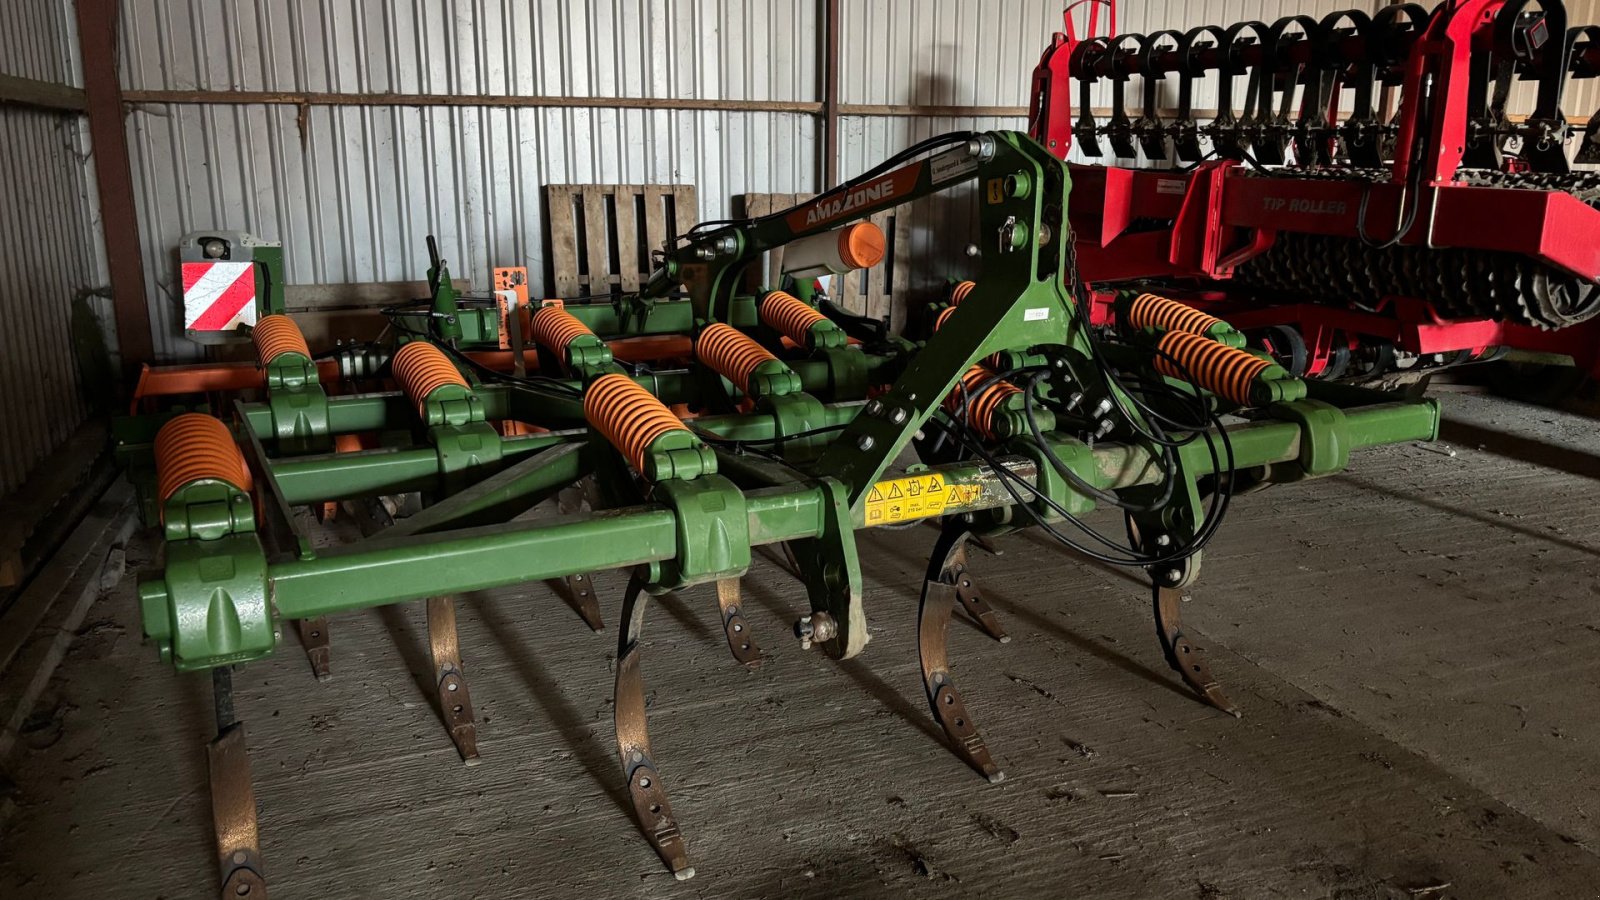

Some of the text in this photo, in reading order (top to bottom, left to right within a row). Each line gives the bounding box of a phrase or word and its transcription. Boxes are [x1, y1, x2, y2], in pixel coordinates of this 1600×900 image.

[806, 179, 894, 225] AMAZONE
[1263, 197, 1346, 214] TIP ROLLER
